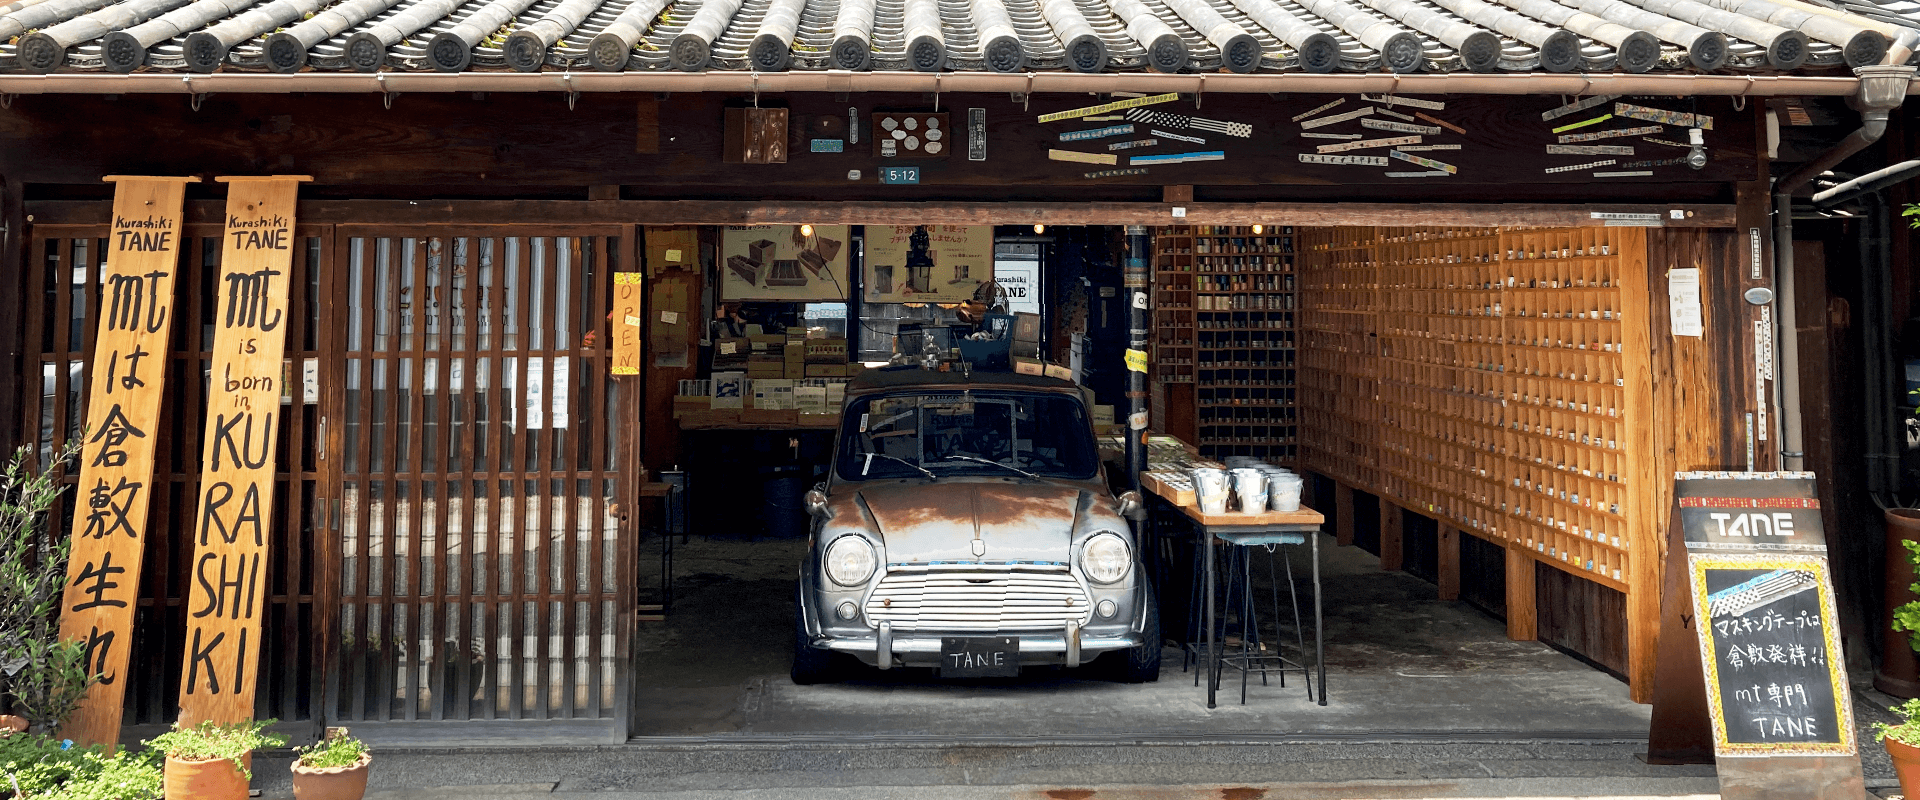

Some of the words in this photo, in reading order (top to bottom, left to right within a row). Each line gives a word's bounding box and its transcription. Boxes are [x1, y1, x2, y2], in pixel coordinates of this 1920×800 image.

[115, 214, 173, 230] Kurashiki
[228, 213, 288, 229] Kurashiki
[116, 230, 172, 252] TANE
[231, 229, 289, 251] TANE
[994, 276, 1027, 284] urashiki
[225, 266, 281, 332] mt
[619, 284, 633, 367] OPEN
[238, 337, 258, 355] is
[224, 362, 273, 393] born
[234, 393, 250, 409] in
[210, 411, 272, 473] KU
[200, 481, 263, 547] RA
[1710, 511, 1795, 537] TANE
[192, 552, 260, 620] SHI
[1714, 609, 1822, 637] マスキングテープは
[186, 627, 247, 695] KI
[950, 651, 1005, 669] TANE
[1752, 717, 1818, 739] TANE
